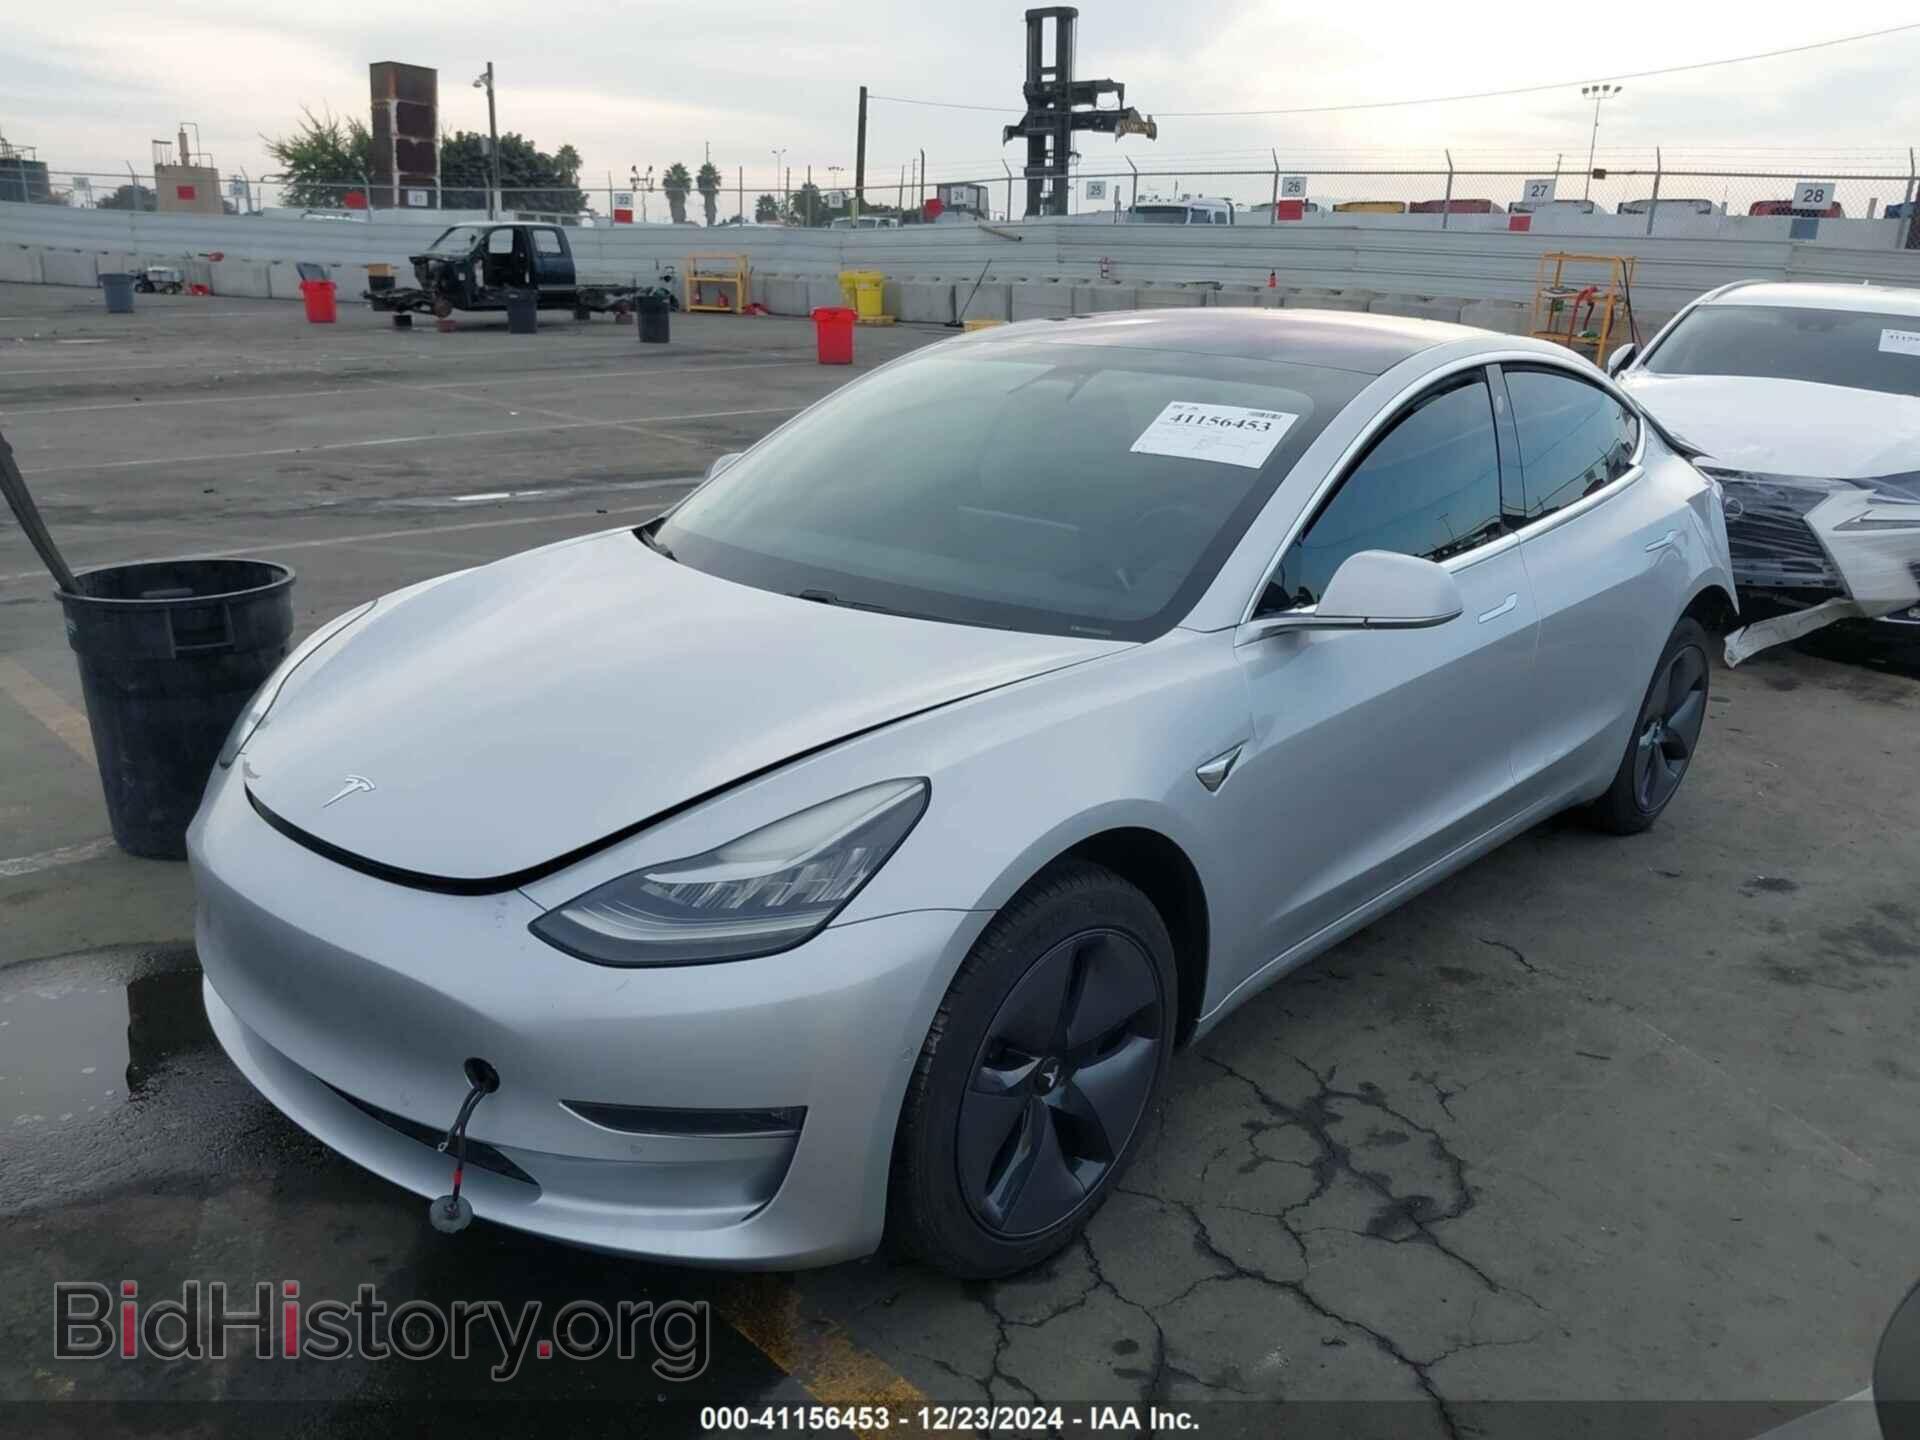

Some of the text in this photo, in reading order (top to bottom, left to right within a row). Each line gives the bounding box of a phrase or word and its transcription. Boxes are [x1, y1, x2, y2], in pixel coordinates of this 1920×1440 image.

[1091, 184, 1102, 196] 25
[1288, 181, 1301, 193] 26
[1531, 184, 1549, 197] 27
[1803, 188, 1824, 203] 28
[1169, 412, 1273, 432] 41156453
